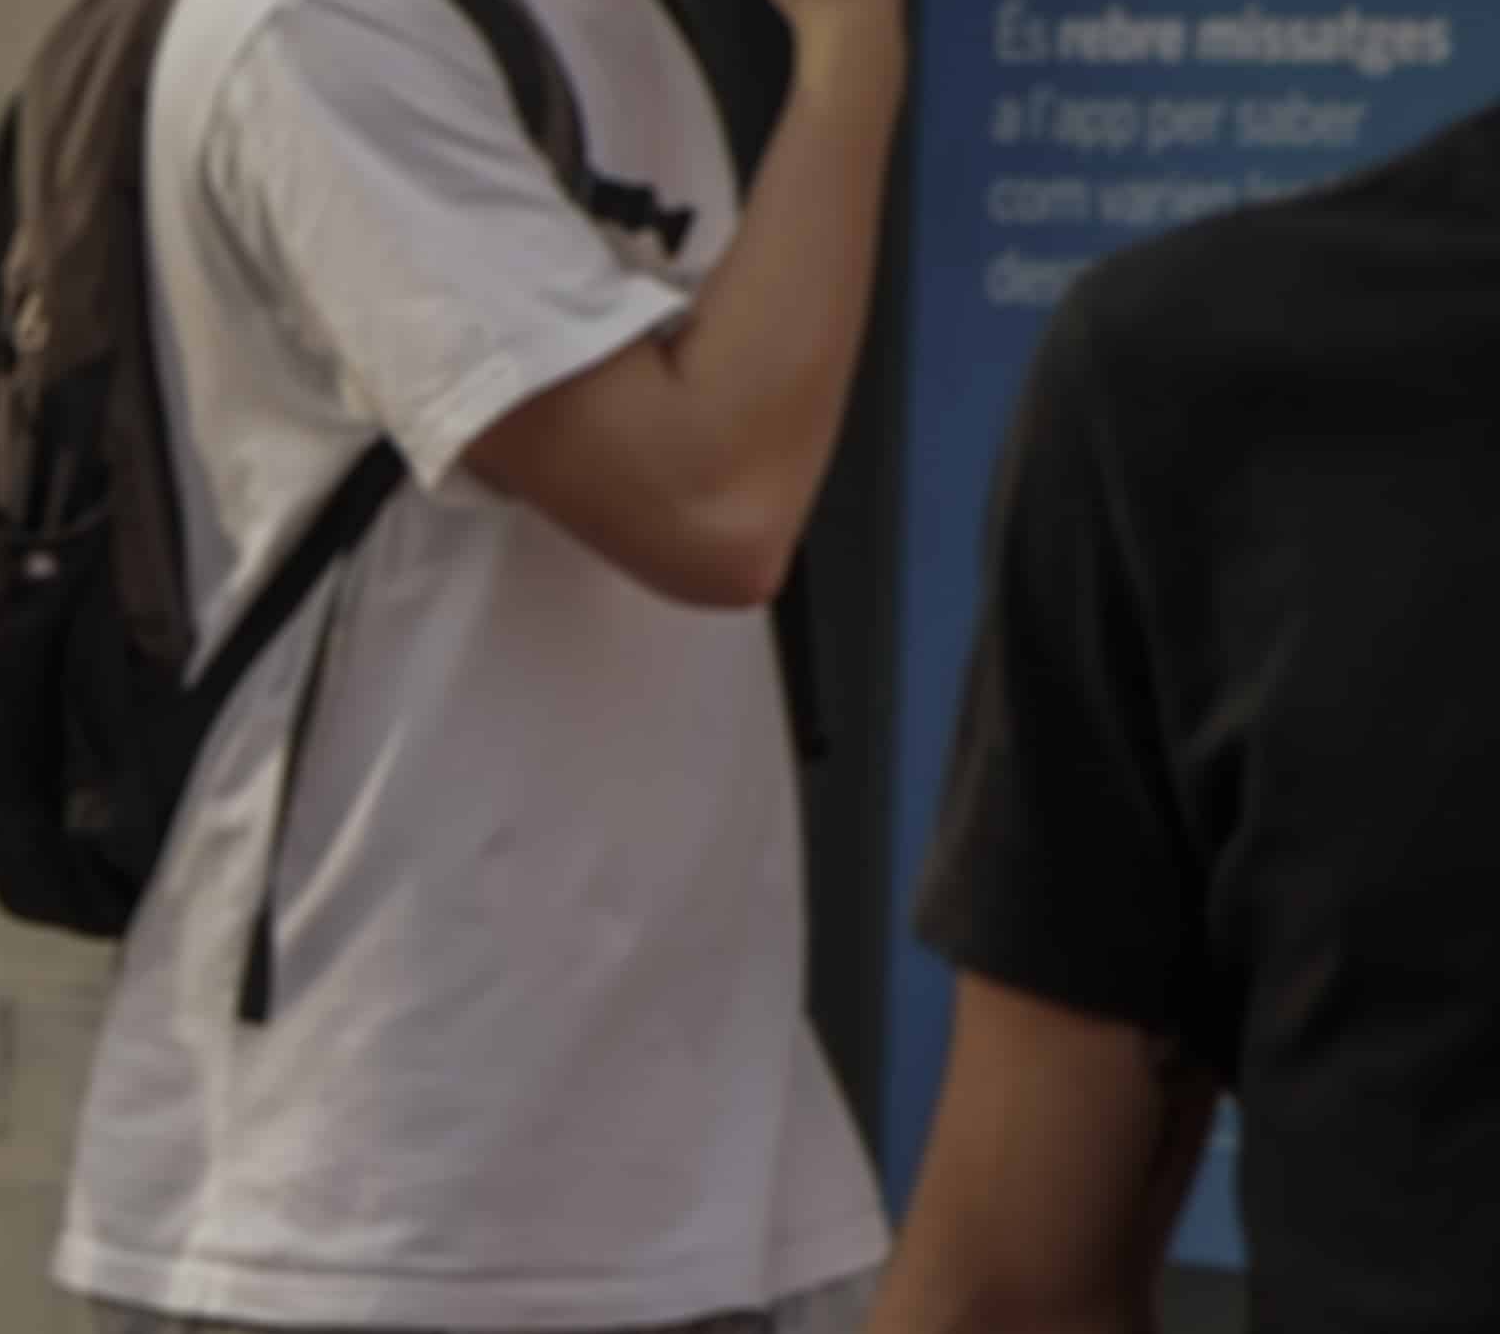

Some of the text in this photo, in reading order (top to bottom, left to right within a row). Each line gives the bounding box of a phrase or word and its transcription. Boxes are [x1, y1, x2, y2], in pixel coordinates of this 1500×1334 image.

[1058, 2, 1186, 61] rebre
[1197, 0, 1453, 78] missatges
[1146, 101, 1228, 153] per
[1237, 91, 1365, 144] saber
